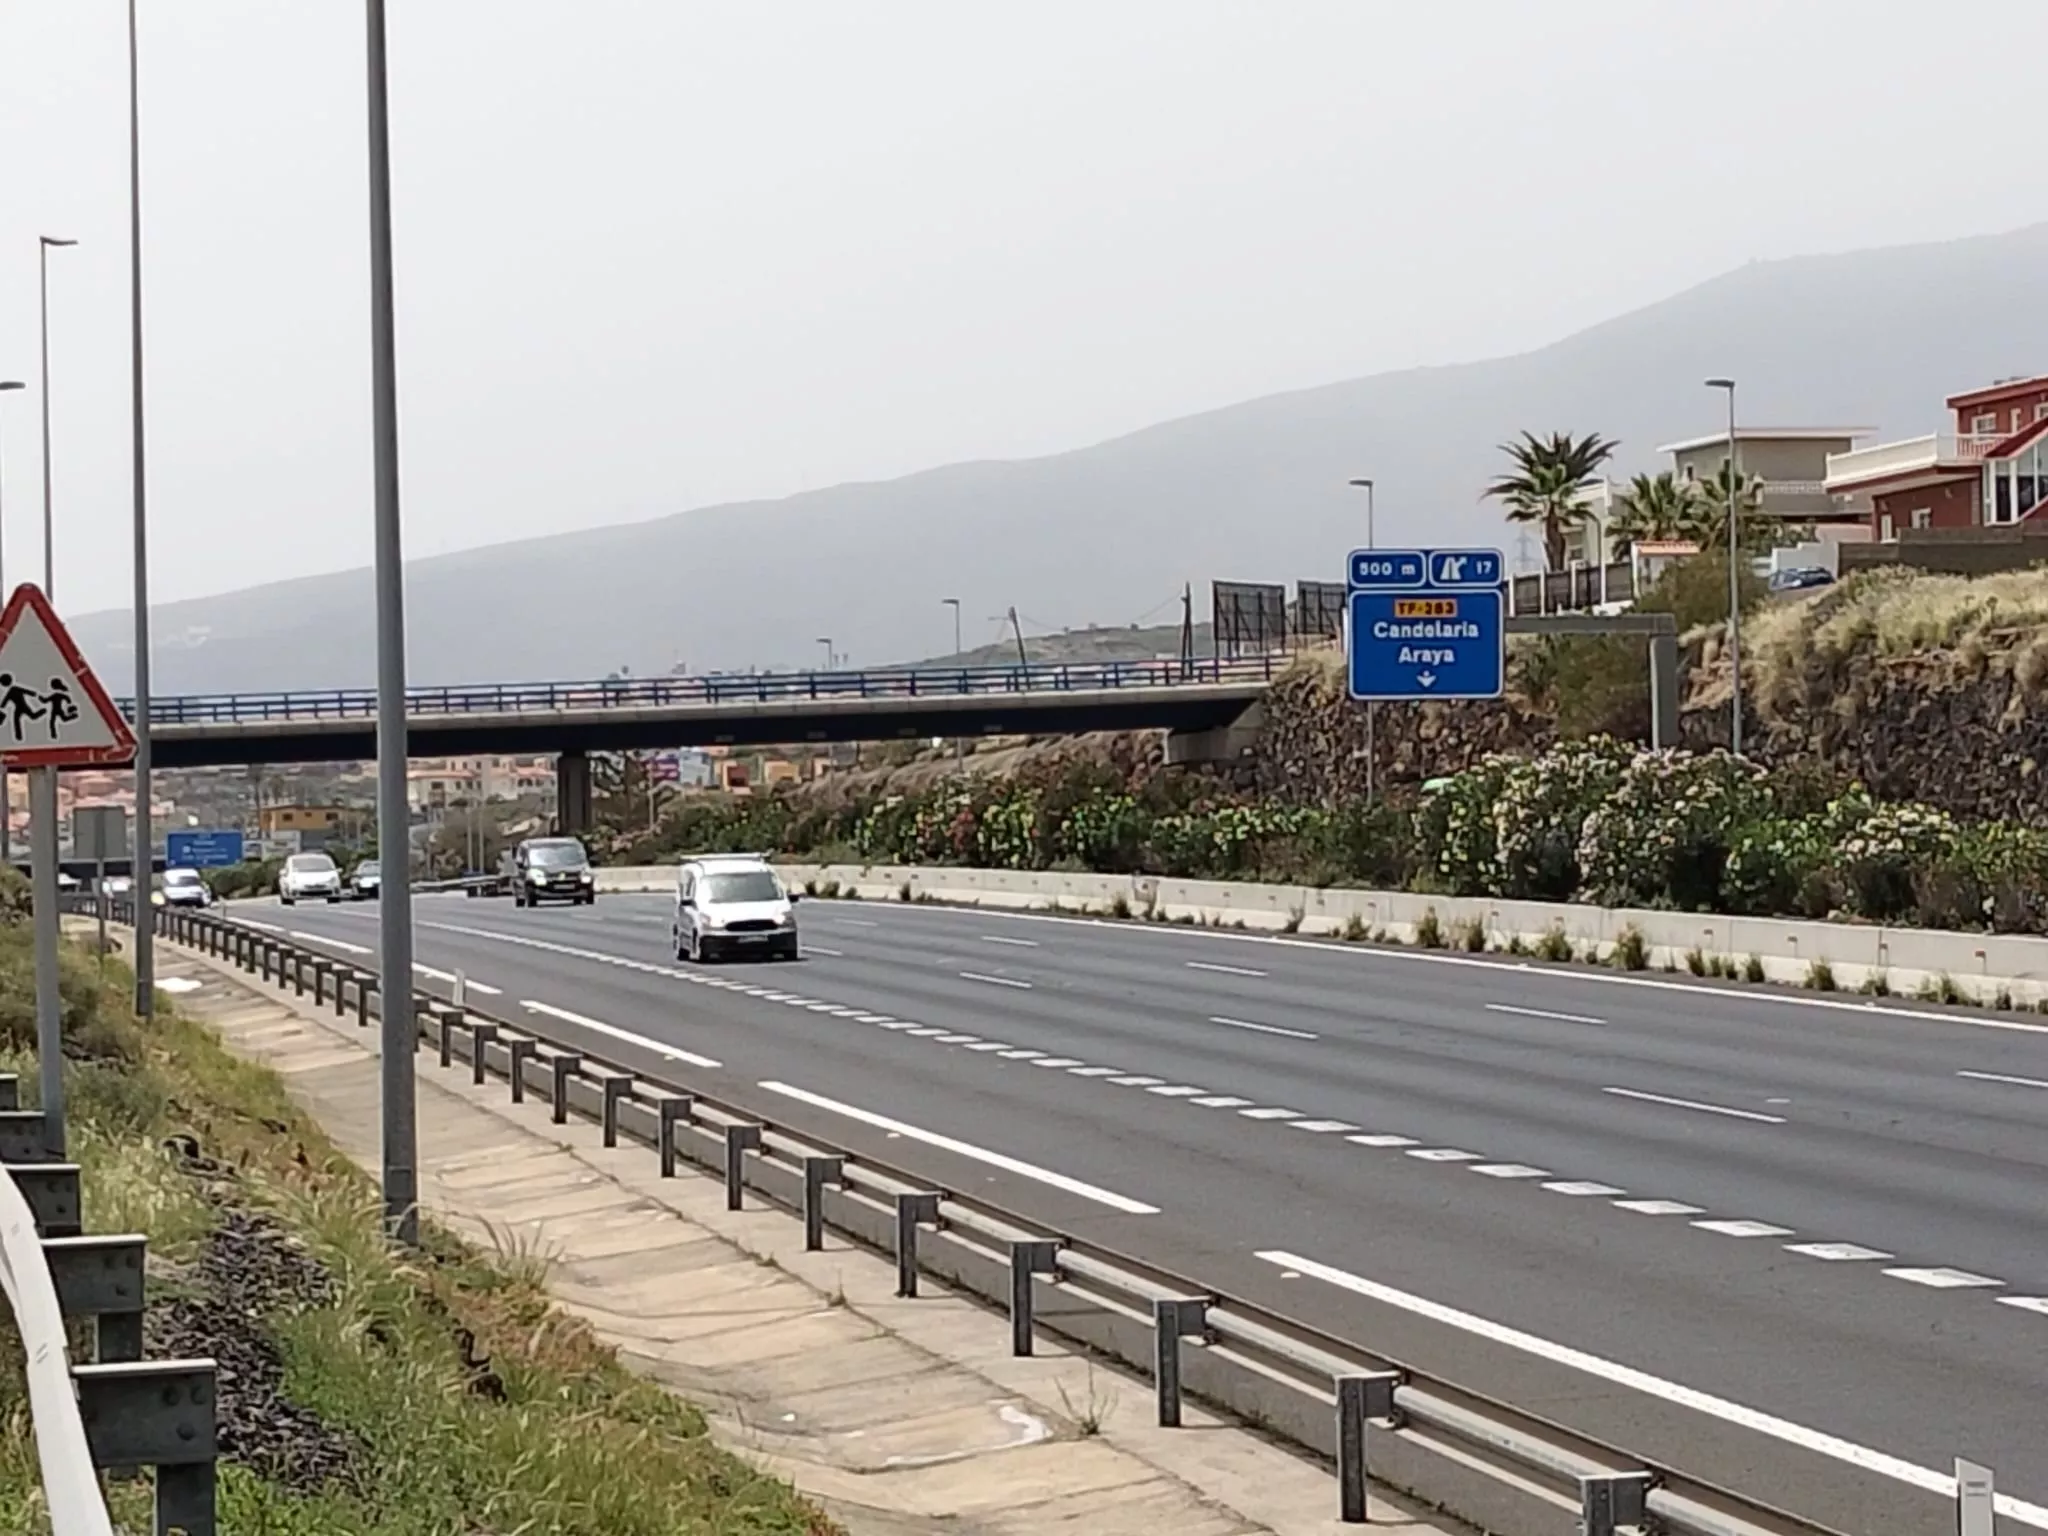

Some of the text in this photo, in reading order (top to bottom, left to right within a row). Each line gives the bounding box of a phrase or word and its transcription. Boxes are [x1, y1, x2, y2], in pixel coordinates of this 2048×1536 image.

[1359, 562, 1416, 576] 500 m
[1476, 561, 1492, 575] 17
[1373, 620, 1479, 638] Candelaria
[1398, 646, 1455, 666] Araya
